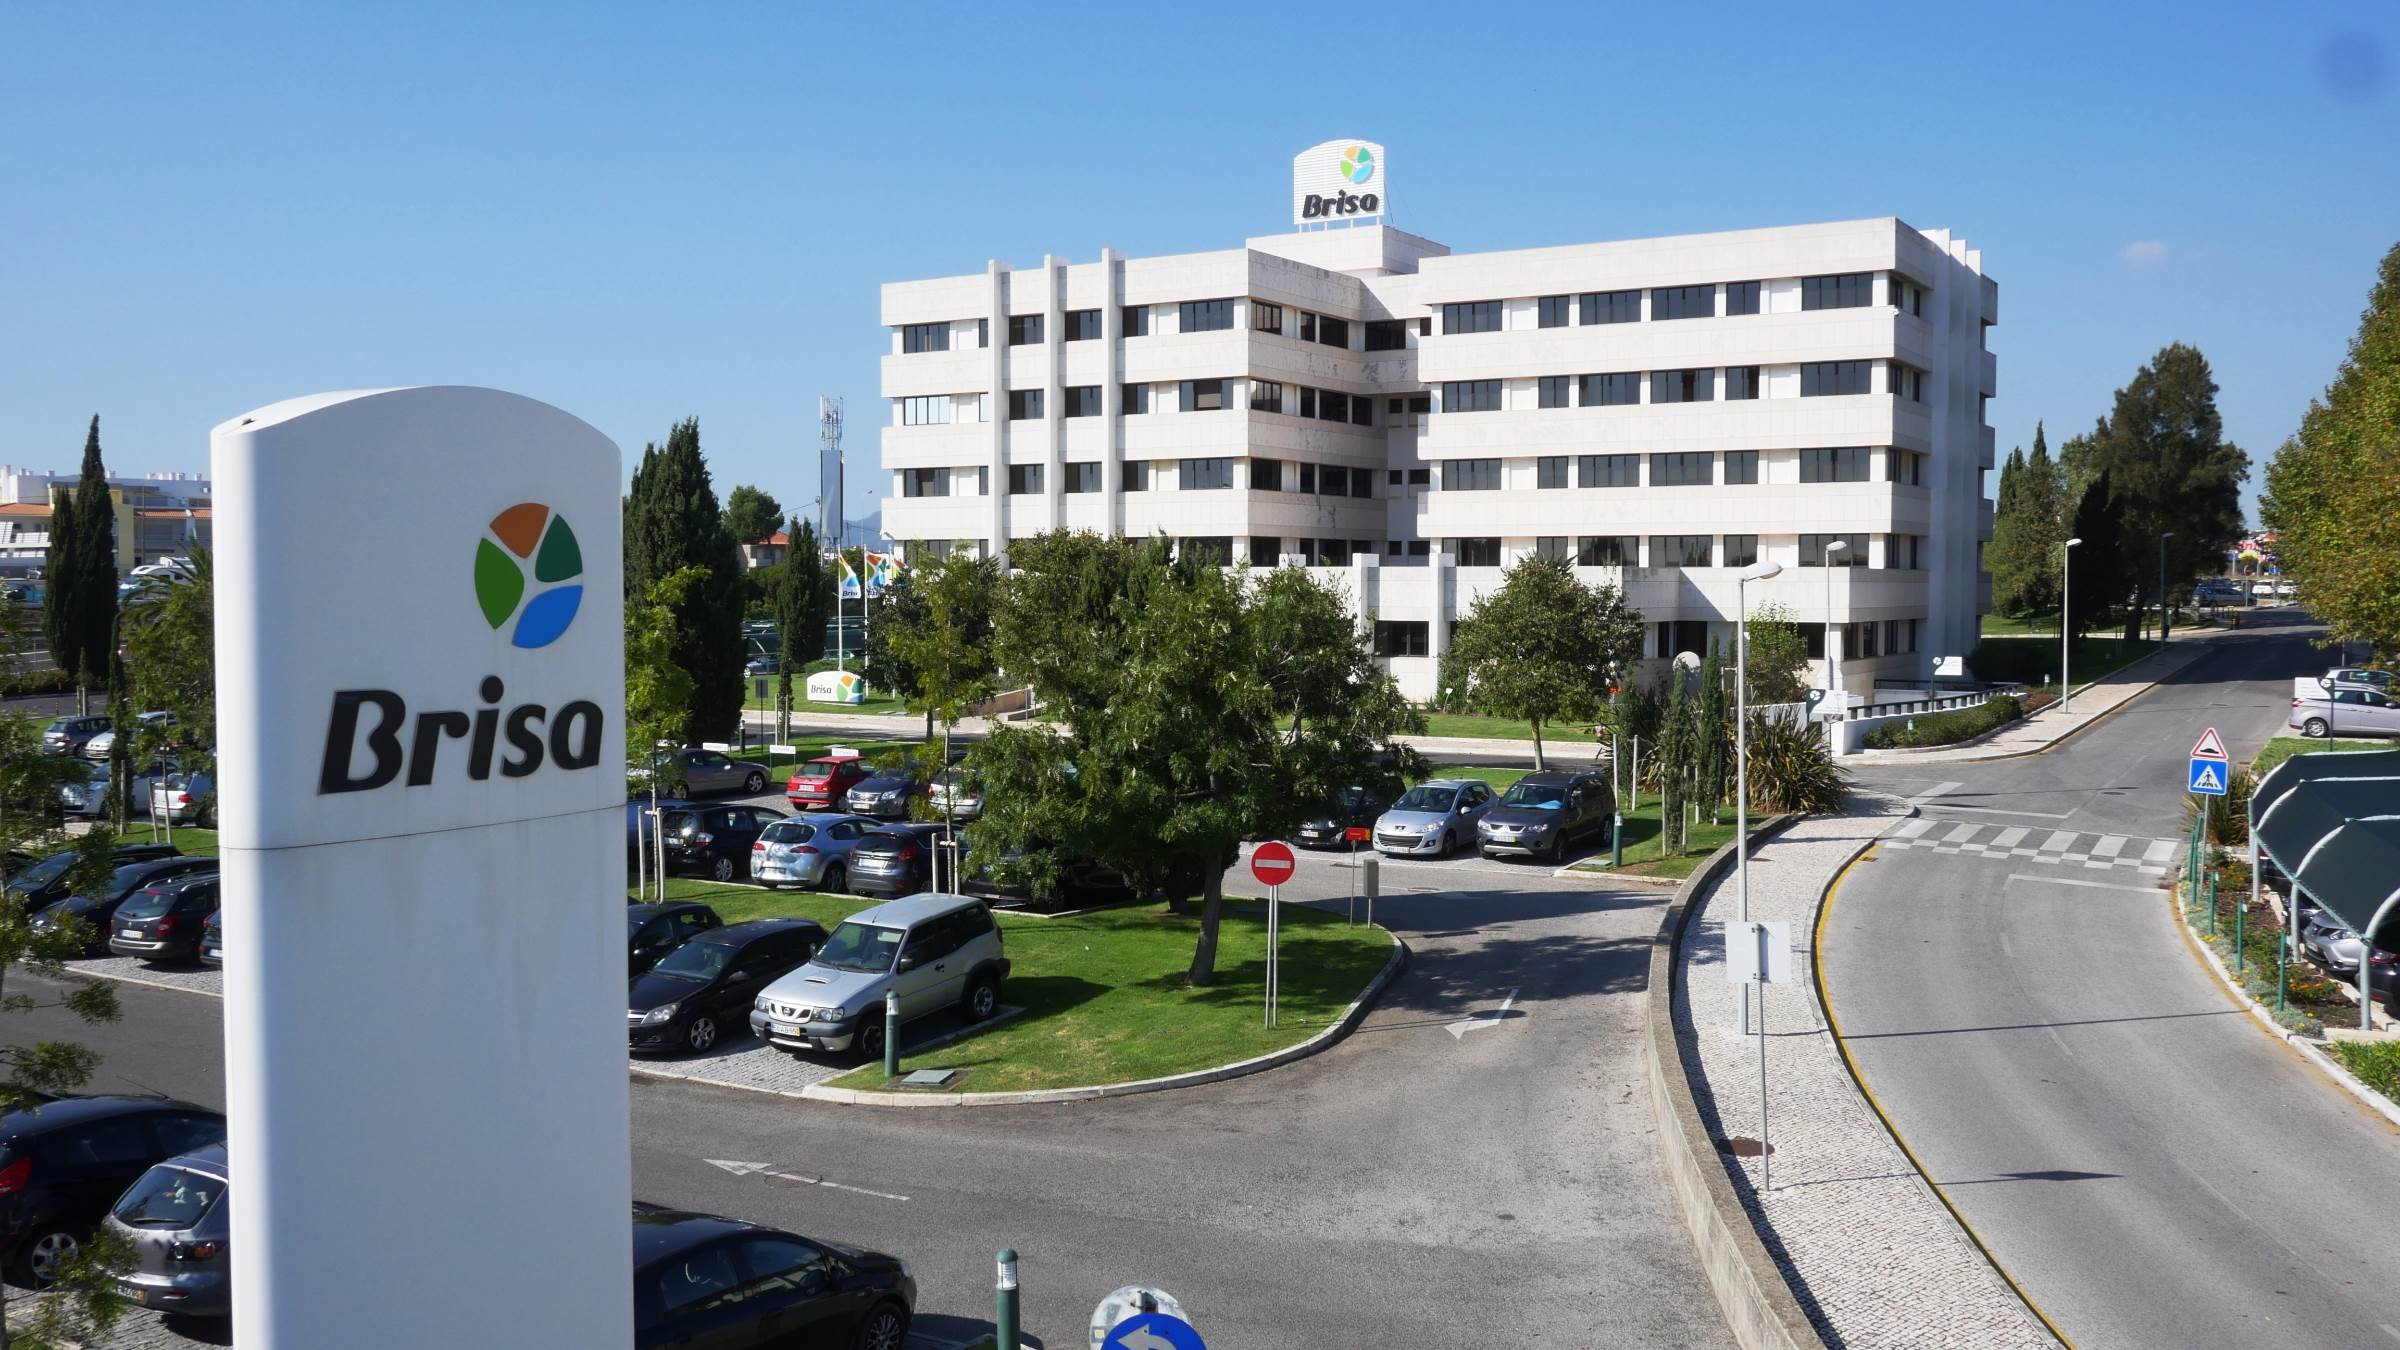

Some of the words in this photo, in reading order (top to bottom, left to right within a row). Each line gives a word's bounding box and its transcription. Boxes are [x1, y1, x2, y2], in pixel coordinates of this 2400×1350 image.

[1302, 189, 1379, 218] Brisa
[811, 684, 832, 694] Brisa
[318, 675, 603, 795] Brisa
